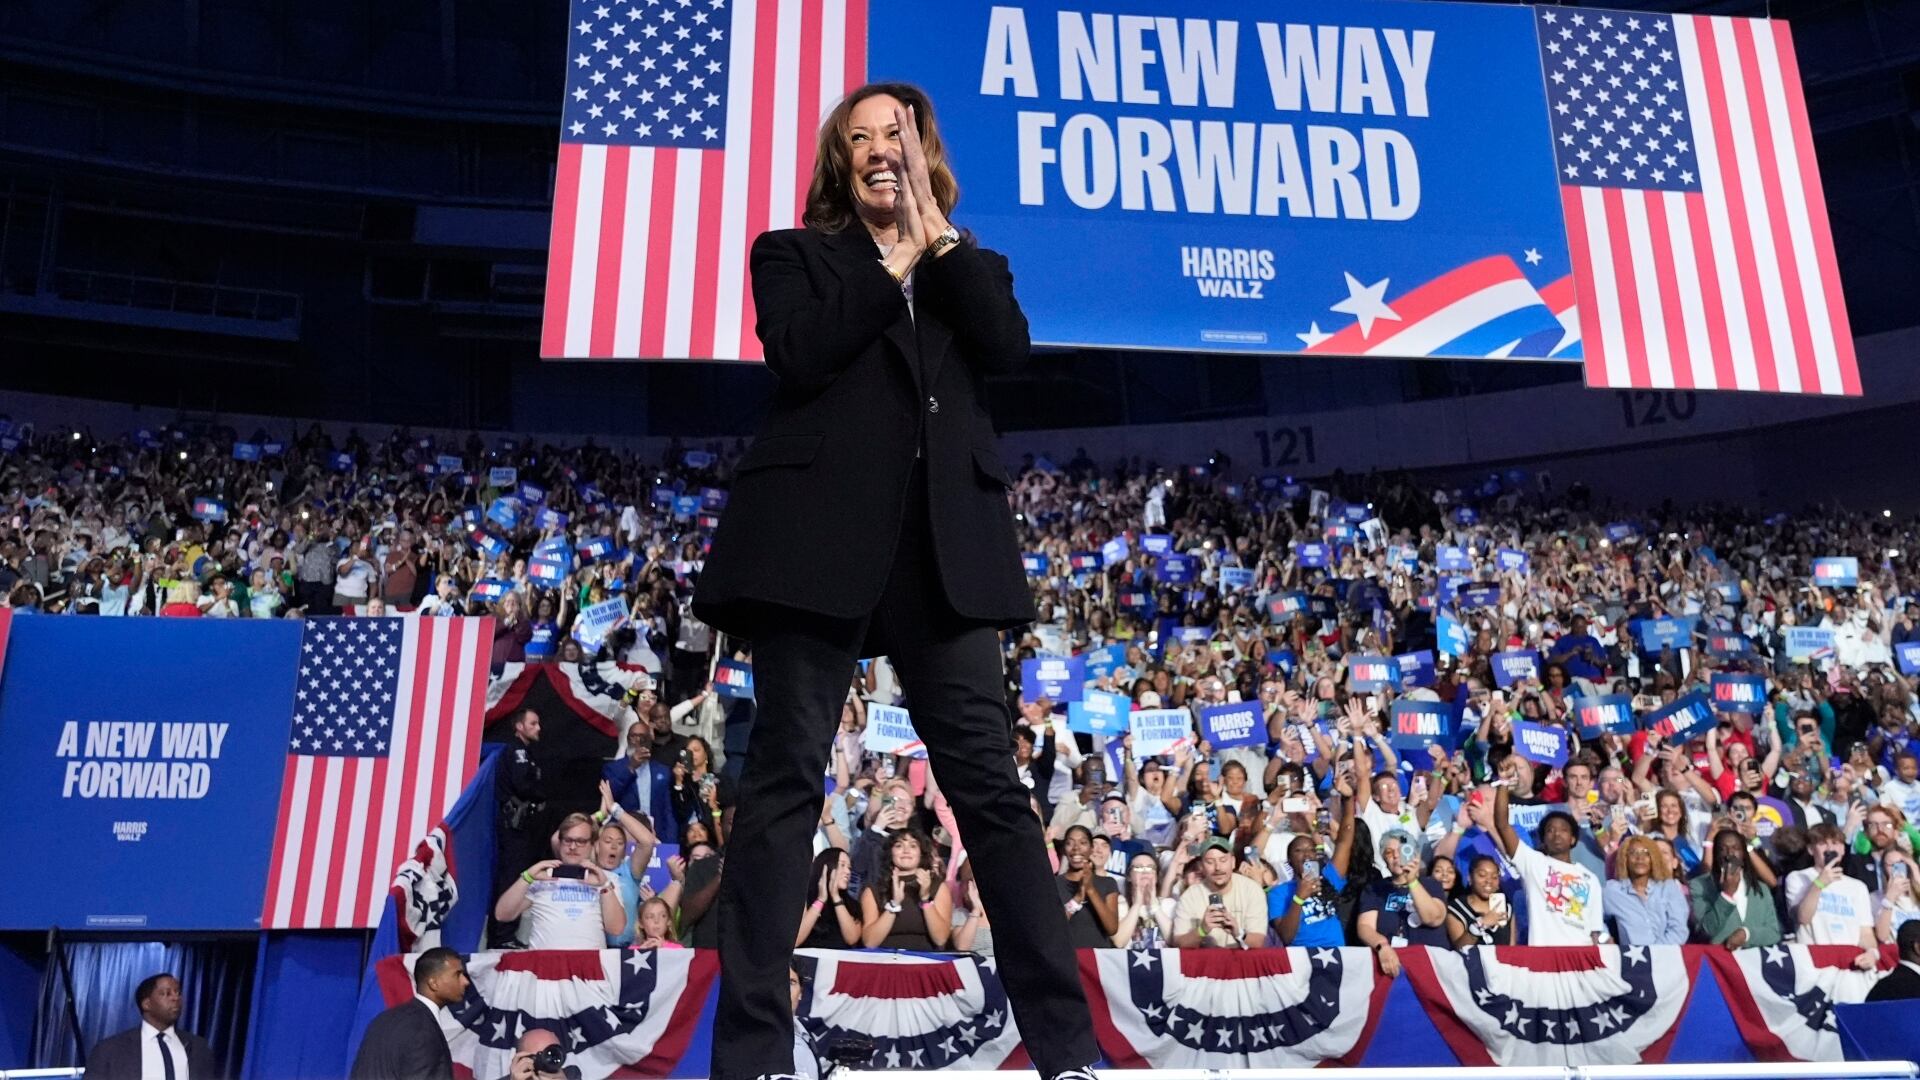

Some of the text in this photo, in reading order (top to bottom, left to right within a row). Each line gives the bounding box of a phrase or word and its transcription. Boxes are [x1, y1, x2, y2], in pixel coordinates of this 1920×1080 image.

[980, 6, 1435, 117] A NEW WAY
[1017, 111, 1421, 221] FORWARD
[1181, 246, 1275, 280] HARRIS
[1197, 279, 1264, 299] WALZ
[1615, 389, 1697, 429] 120
[1254, 425, 1315, 468] 121
[1354, 664, 1398, 682] KAMALA
[1715, 683, 1765, 702] KAMALA
[874, 709, 881, 721] A
[883, 712, 903, 725] NEW
[1137, 714, 1185, 727] A NEW WAY
[1210, 711, 1255, 734] HARRIS
[1397, 712, 1449, 735] KAMALA
[1580, 704, 1630, 727] KAMALA
[1653, 702, 1709, 736] KAMALA
[56, 720, 229, 759] A NEW WAY
[877, 723, 916, 740] FORWAR
[1218, 728, 1250, 741] WALZ
[1522, 729, 1560, 750] HARRIS
[62, 761, 211, 799] FORWARD
[113, 821, 148, 834] HARRIS
[1514, 814, 1520, 825] A
[117, 833, 141, 842] WALZ
